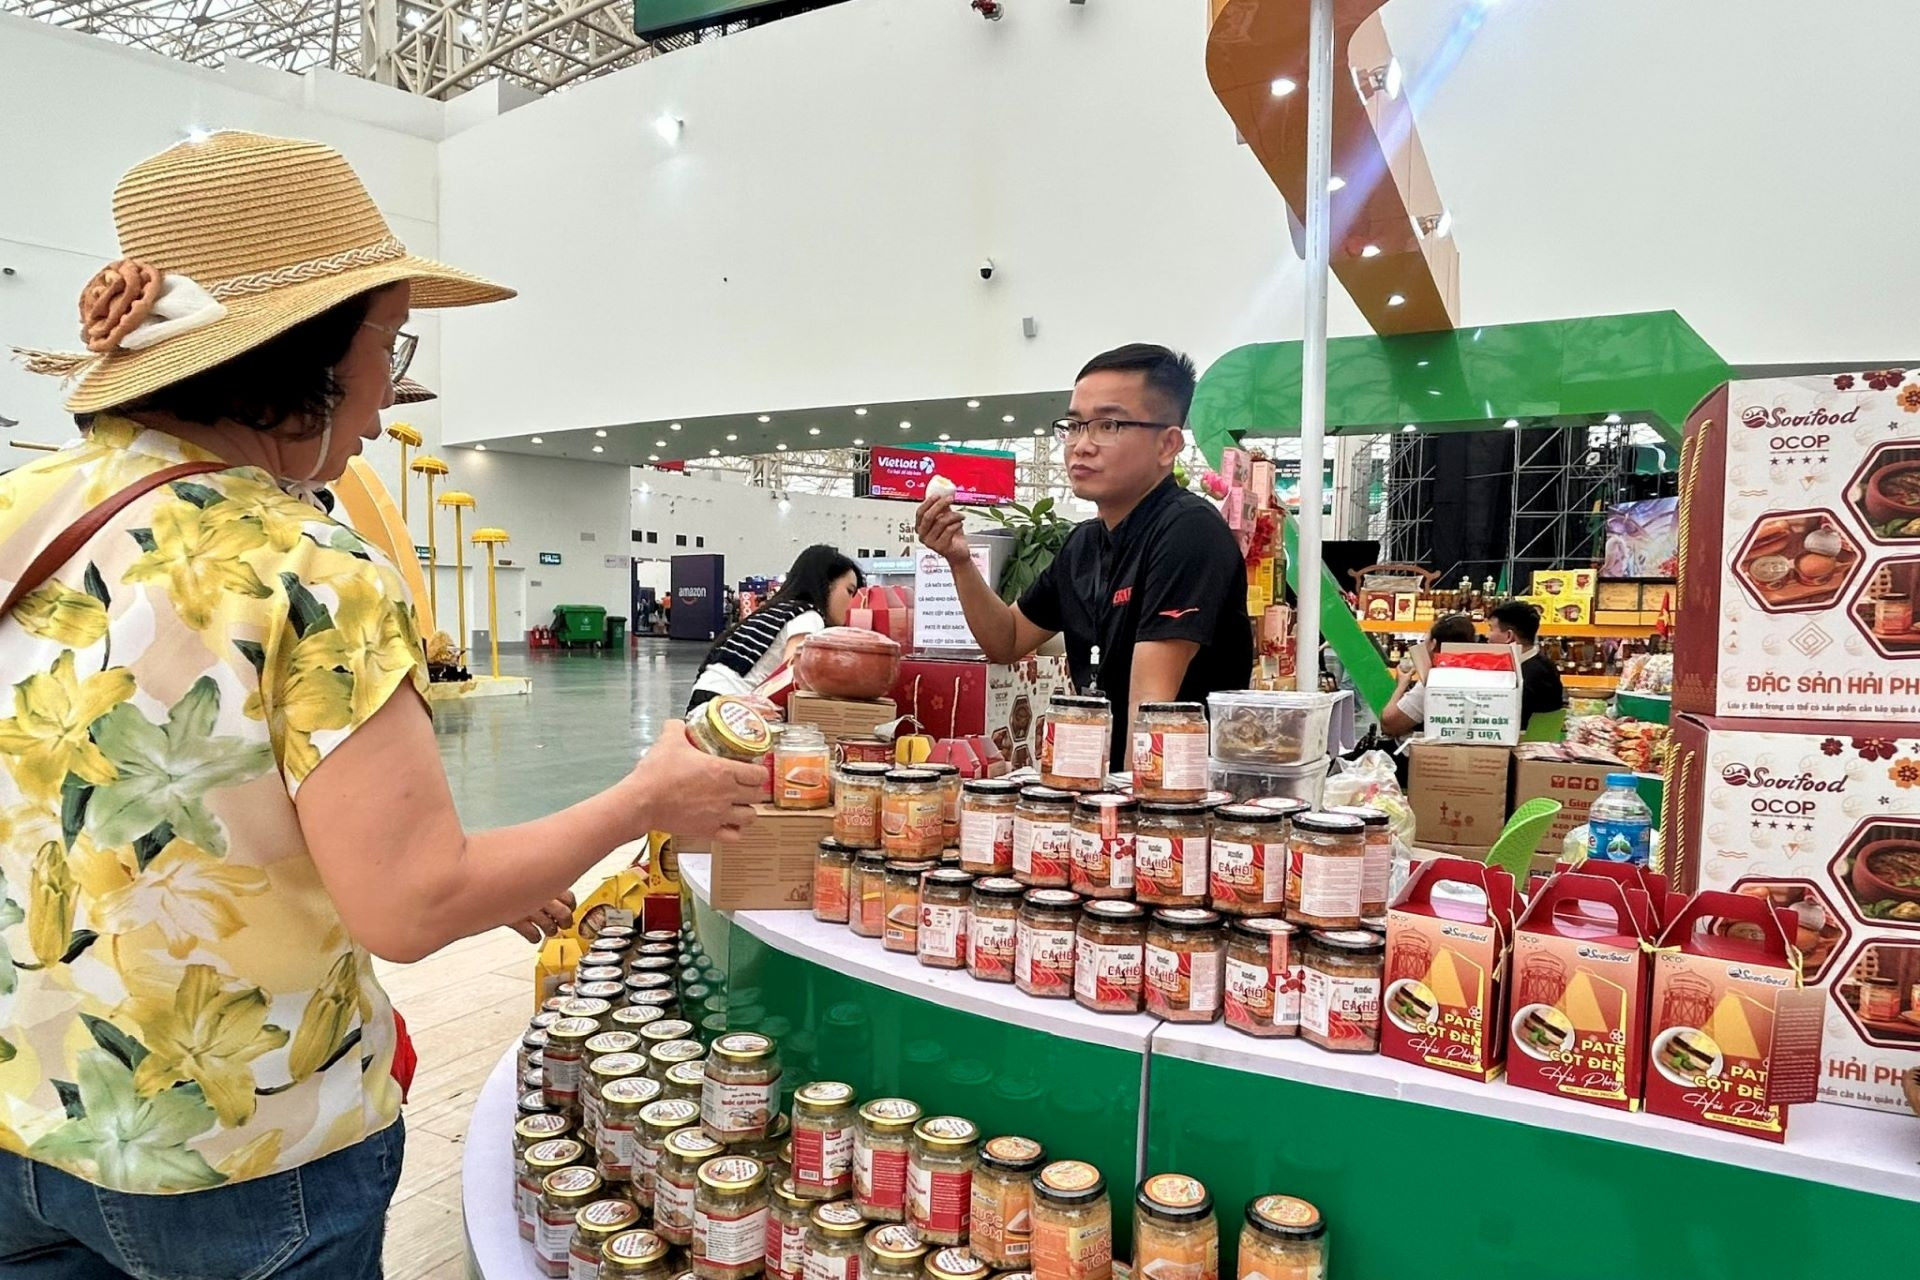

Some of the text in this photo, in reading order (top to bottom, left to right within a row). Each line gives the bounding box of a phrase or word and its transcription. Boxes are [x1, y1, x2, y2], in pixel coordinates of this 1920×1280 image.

[1766, 406, 1860, 429] Sovifood
[1770, 435, 1830, 450] OCOP
[878, 456, 918, 469] Vietlott
[899, 535, 914, 543] Hall
[678, 586, 706, 597] amazon
[1747, 672, 1790, 696] ĐẶC
[1797, 671, 1842, 694] SẢN
[1848, 672, 1882, 694] HẢI
[1766, 703, 1784, 712] trong
[1478, 730, 1502, 740] Vân
[1747, 766, 1848, 793] Sovifood
[1751, 798, 1816, 815] OCOP
[1000, 936, 1014, 948] HỒ
[1058, 950, 1074, 960] HỒ
[1126, 963, 1142, 976] HỒ
[1342, 999, 1378, 1012] CÁ HỒ
[1444, 1013, 1482, 1030] PATE
[1416, 1022, 1481, 1046] CỘT ĐÈN
[1582, 1040, 1625, 1056] PATE
[1550, 1050, 1625, 1073] CỘT ĐÈN
[1828, 1056, 1867, 1082] HẢI
[1731, 1065, 1768, 1082] PAT
[1694, 1076, 1764, 1100] CỘT ĐÈ
